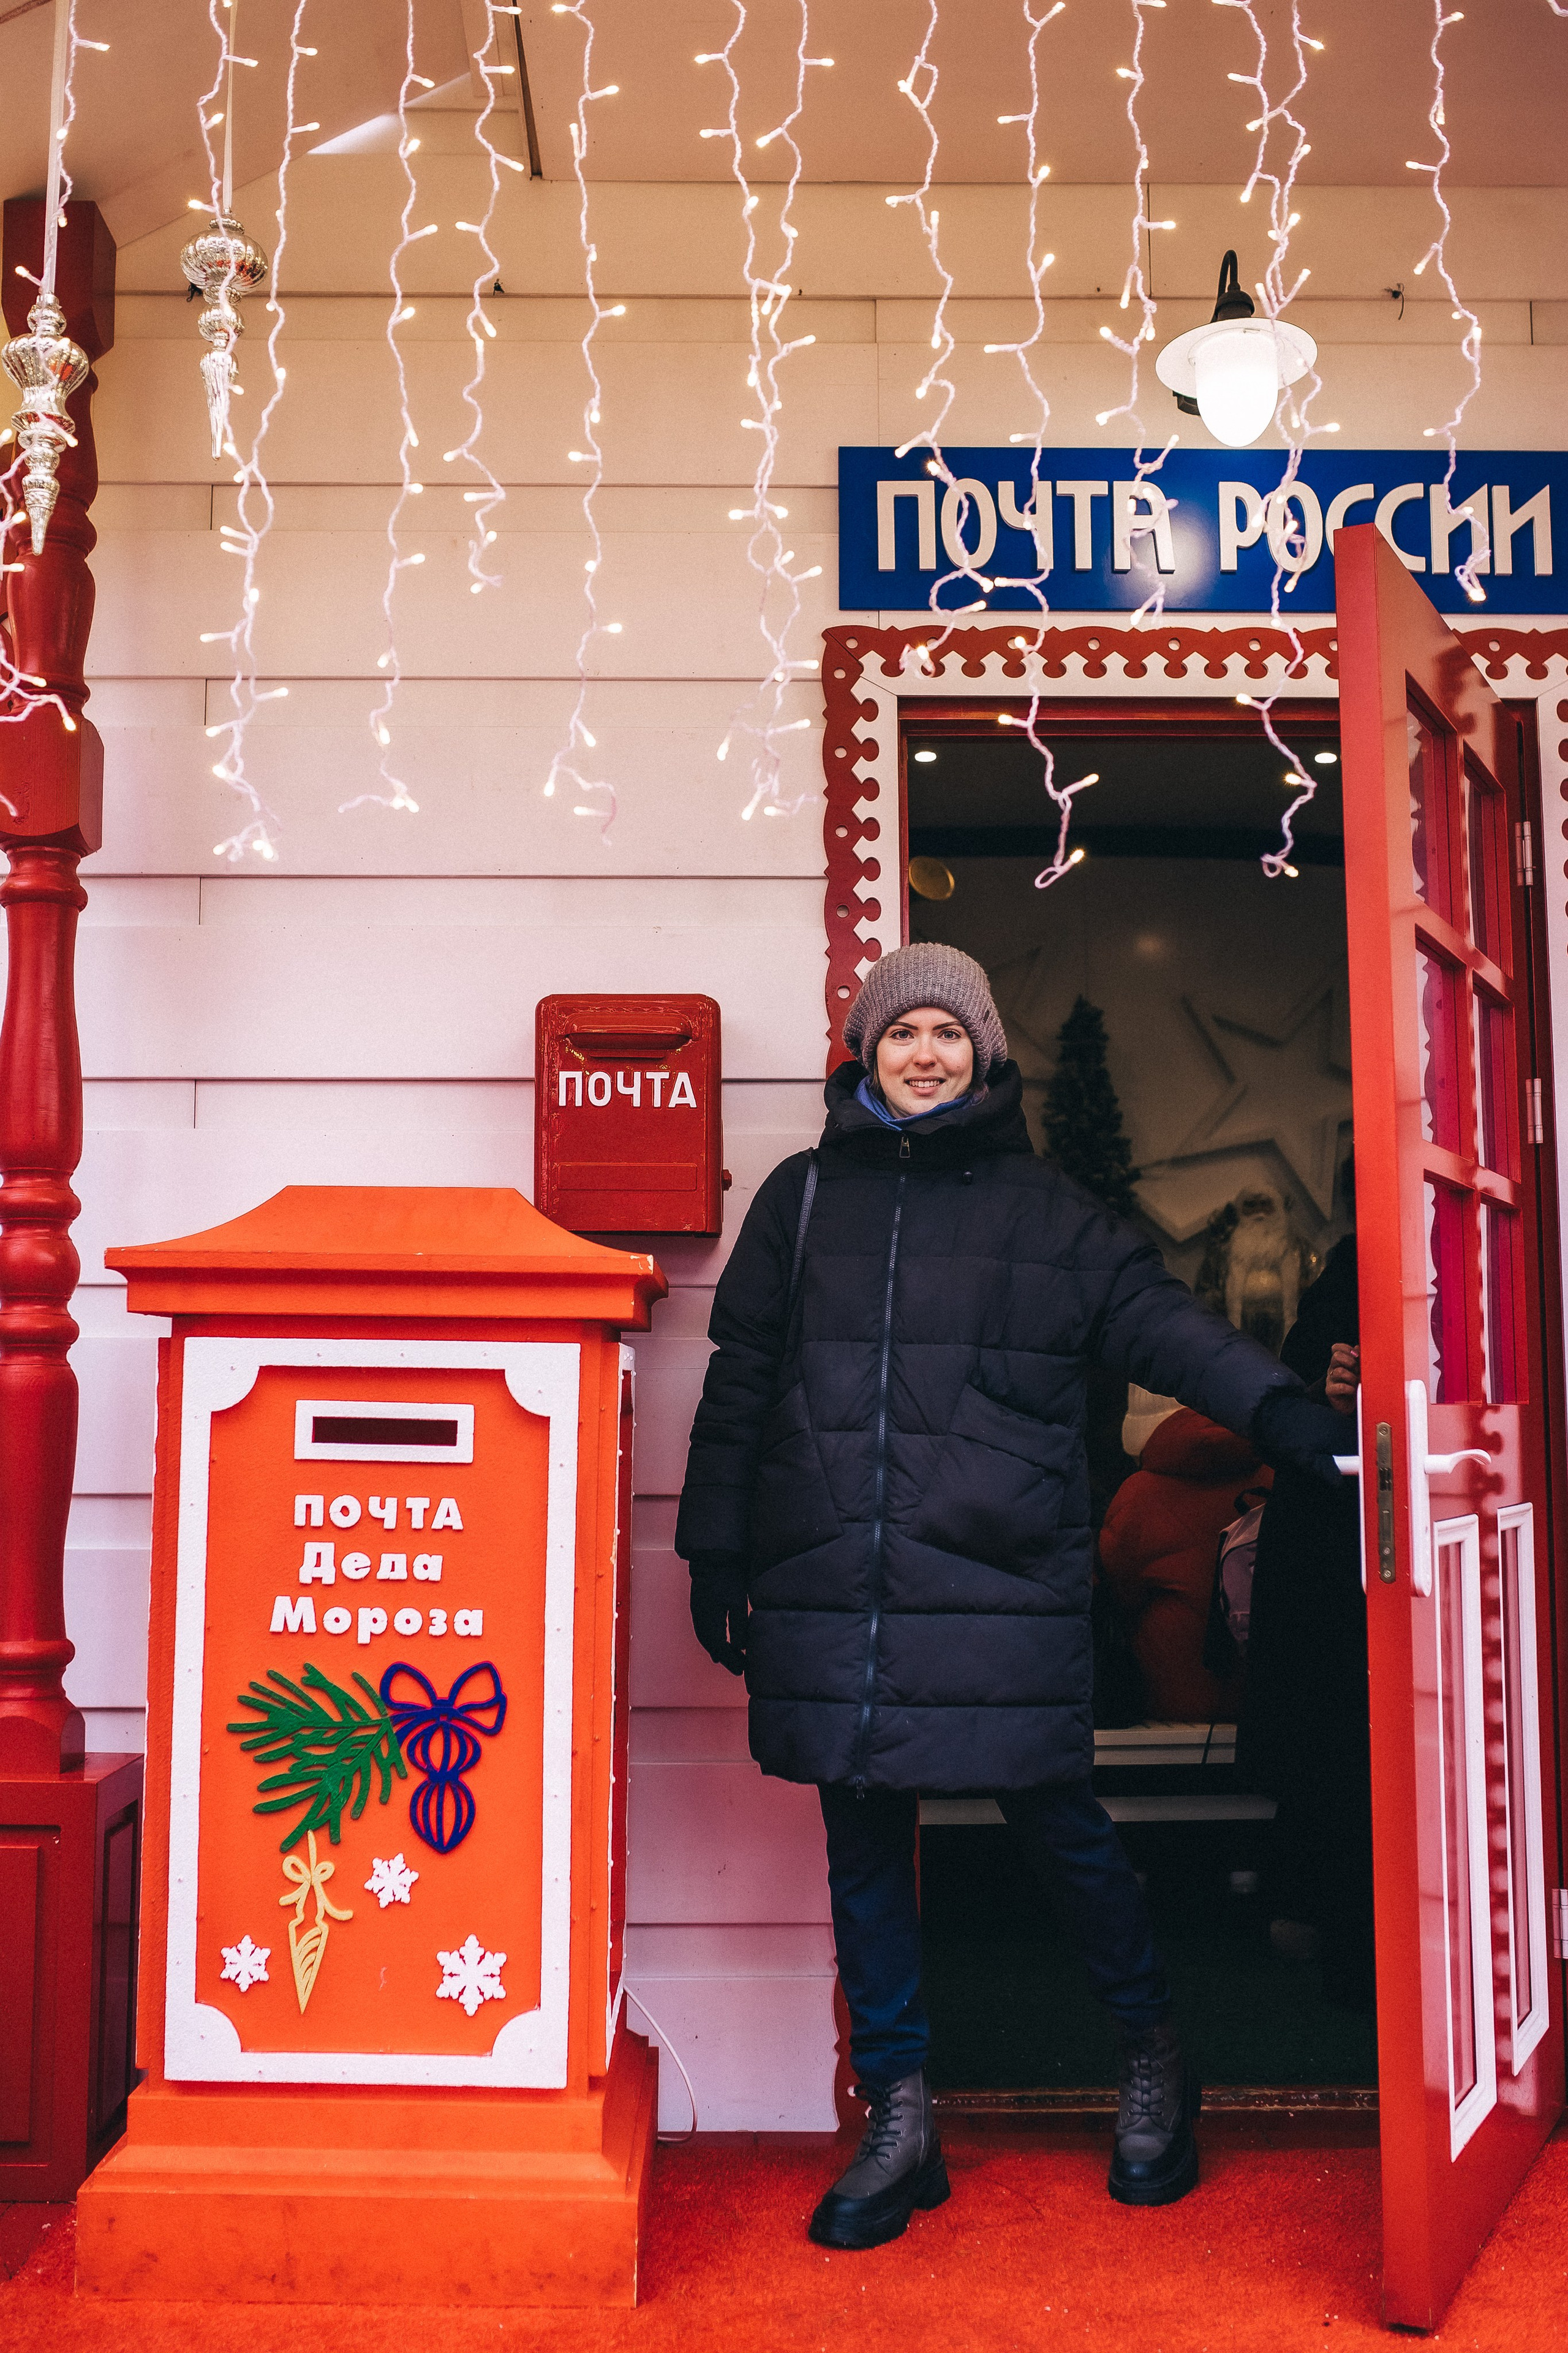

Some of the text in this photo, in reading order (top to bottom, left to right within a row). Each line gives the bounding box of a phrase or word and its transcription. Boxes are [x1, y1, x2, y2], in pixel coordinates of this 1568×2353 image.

[876, 480, 1552, 576] ПОЧТА РОССИИ
[558, 1070, 698, 1108] ПОЧТА
[293, 1494, 464, 1530] ПОЧТА
[298, 1541, 444, 1585] Деда
[269, 1595, 484, 1645] Мороза
